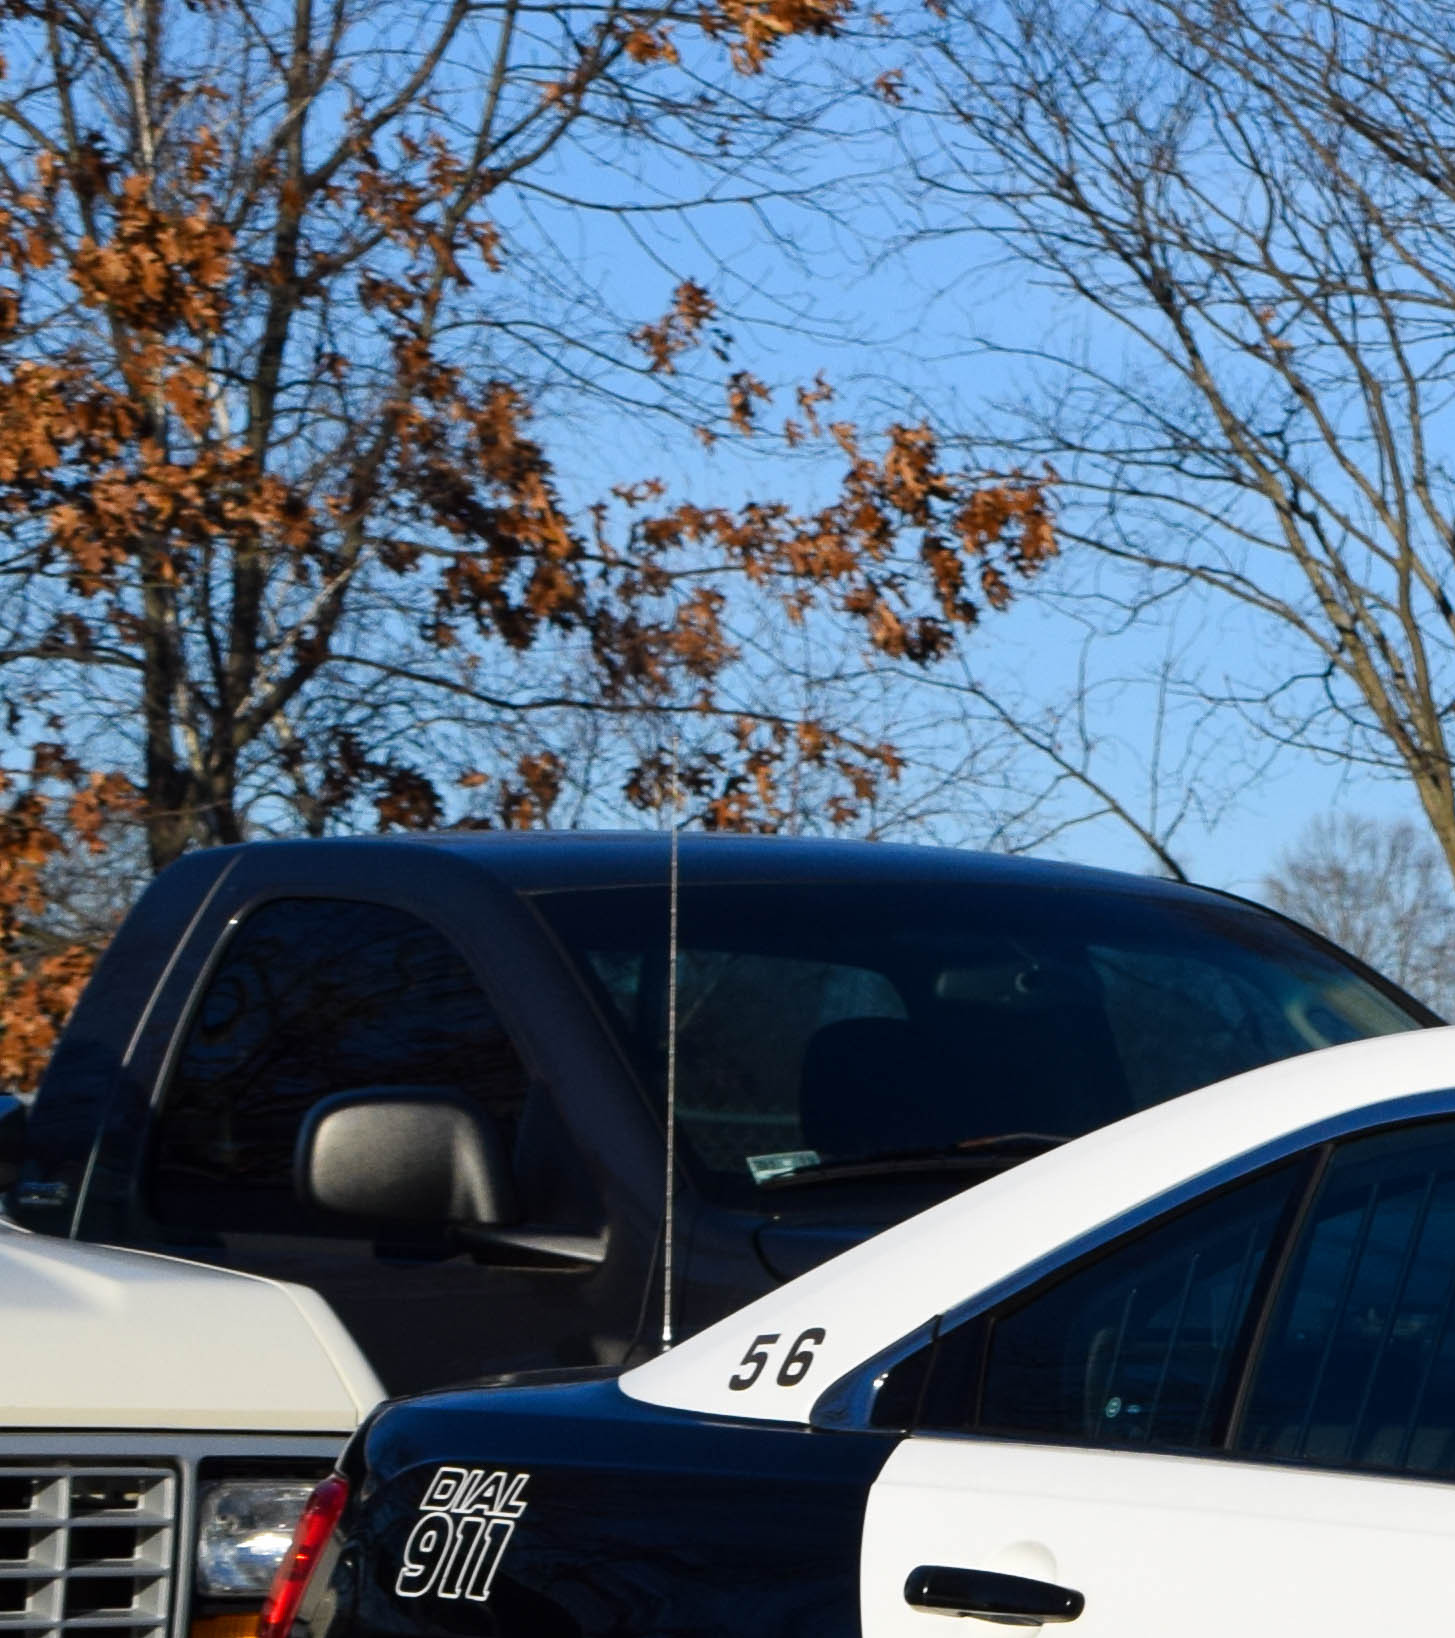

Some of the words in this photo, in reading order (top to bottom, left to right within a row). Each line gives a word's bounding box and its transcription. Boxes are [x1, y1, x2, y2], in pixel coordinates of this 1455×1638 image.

[728, 1327, 826, 1391] 56
[419, 1467, 530, 1518] DIAL
[395, 1511, 515, 1601] 911
